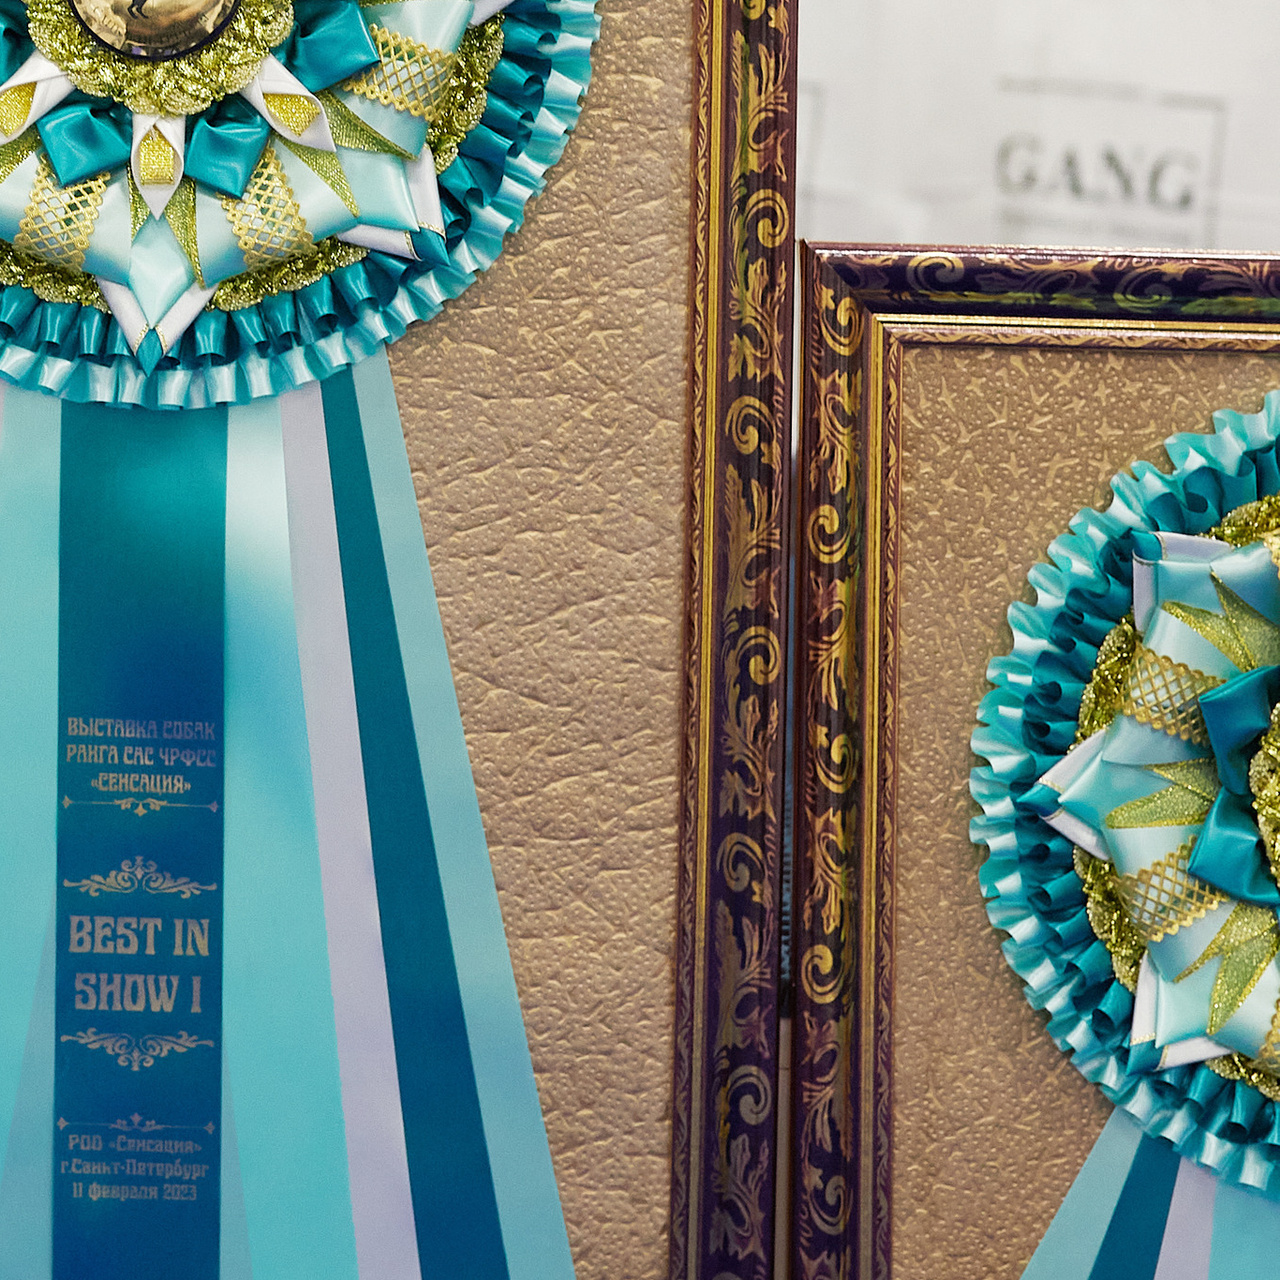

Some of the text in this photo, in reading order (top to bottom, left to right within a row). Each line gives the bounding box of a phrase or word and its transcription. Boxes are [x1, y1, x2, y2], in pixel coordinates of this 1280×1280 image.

[996, 132, 1200, 211] GANG
[67, 717, 216, 741] ВЫСТАВКА СОБАК
[66, 744, 119, 764] РАНГА
[91, 773, 191, 795] «СЕНСАЦИЯ»
[68, 915, 210, 957] BEST IN
[74, 972, 180, 1013] SHOW
[109, 1135, 202, 1154] «Сенсация»
[88, 1182, 159, 1202] февраля
[163, 1183, 197, 1201] 2023
